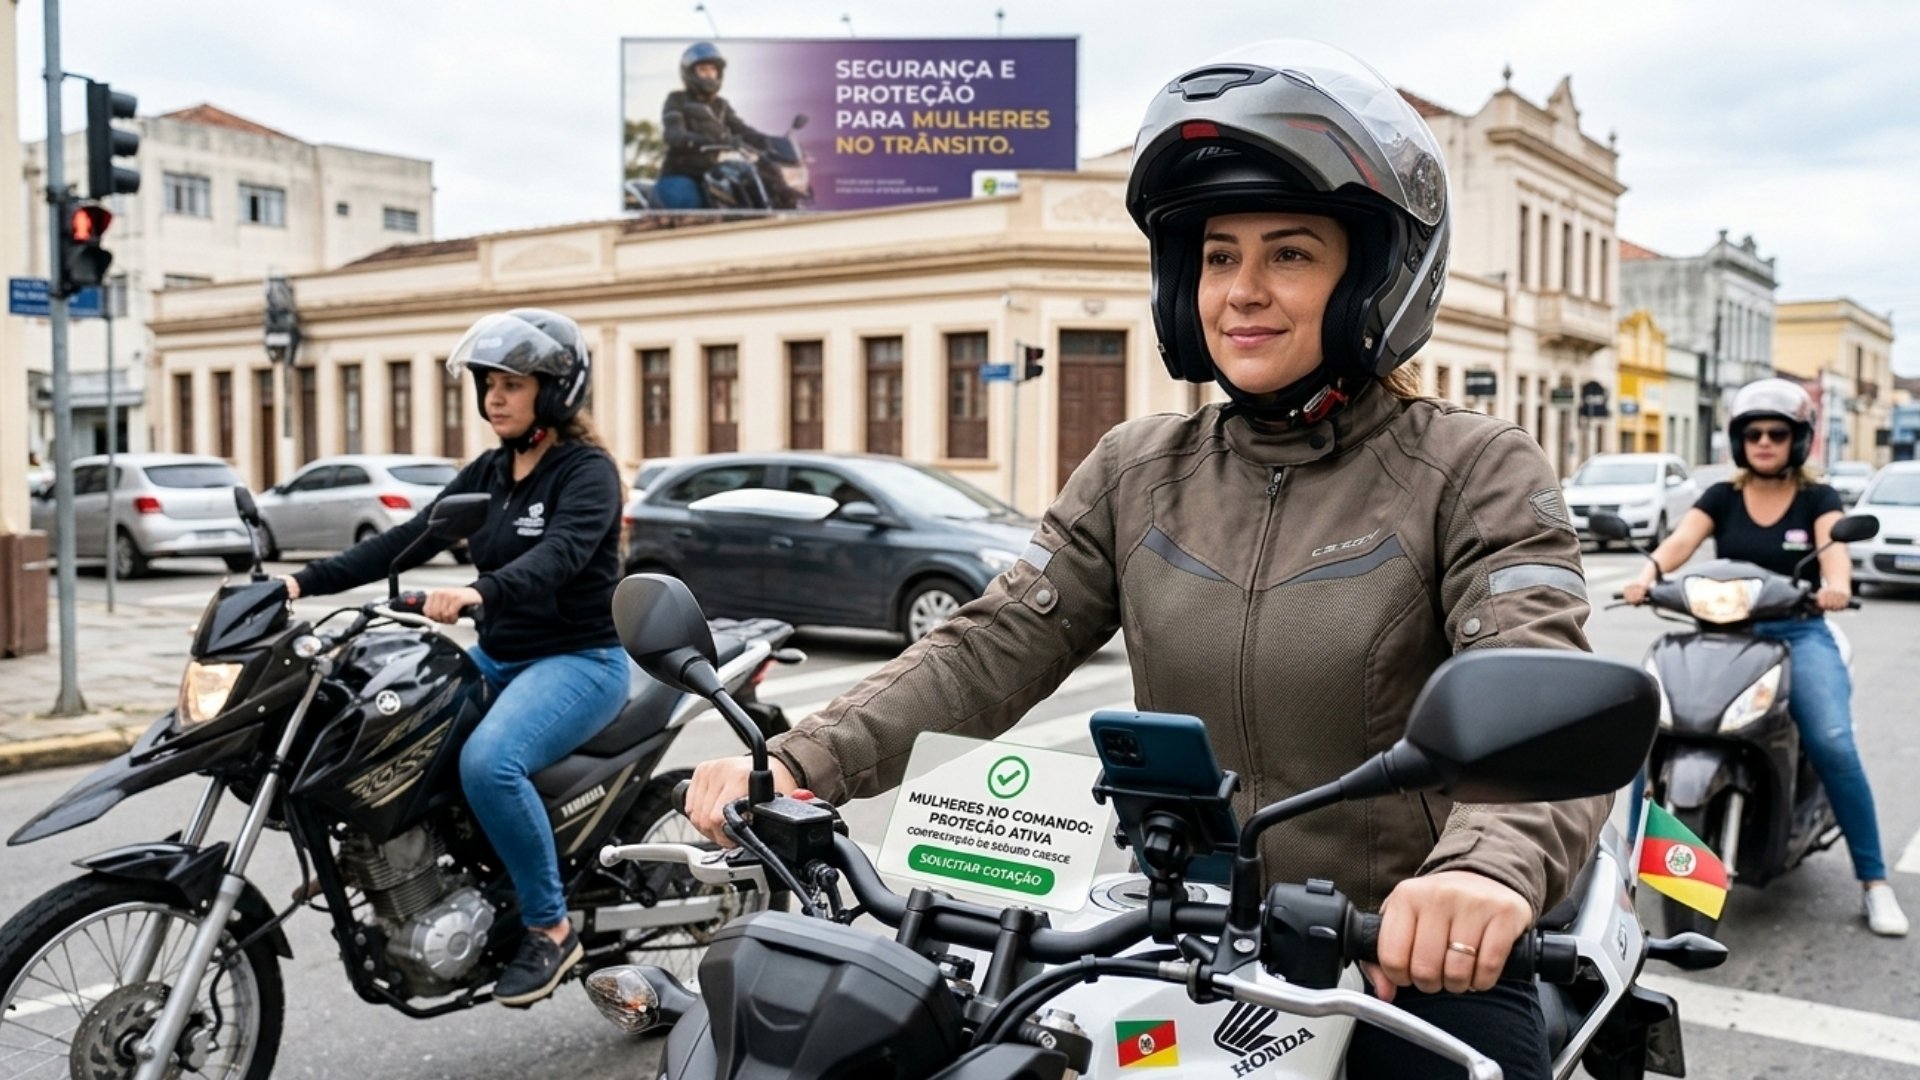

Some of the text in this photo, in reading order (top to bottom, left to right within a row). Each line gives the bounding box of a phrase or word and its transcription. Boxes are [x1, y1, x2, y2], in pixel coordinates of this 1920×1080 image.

[835, 59, 1016, 83] SEGURANÇA E
[836, 80, 975, 107] PROTEÇÃO
[836, 110, 1051, 129] PARA MULHERES
[836, 132, 1015, 155] NO TRÂNSITO.
[908, 791, 1094, 835] MULHERES NO COMANDO:
[1008, 827, 1053, 846] ATIVA
[919, 852, 981, 874] SOLICITAR
[1230, 1026, 1316, 1079] HONDA
